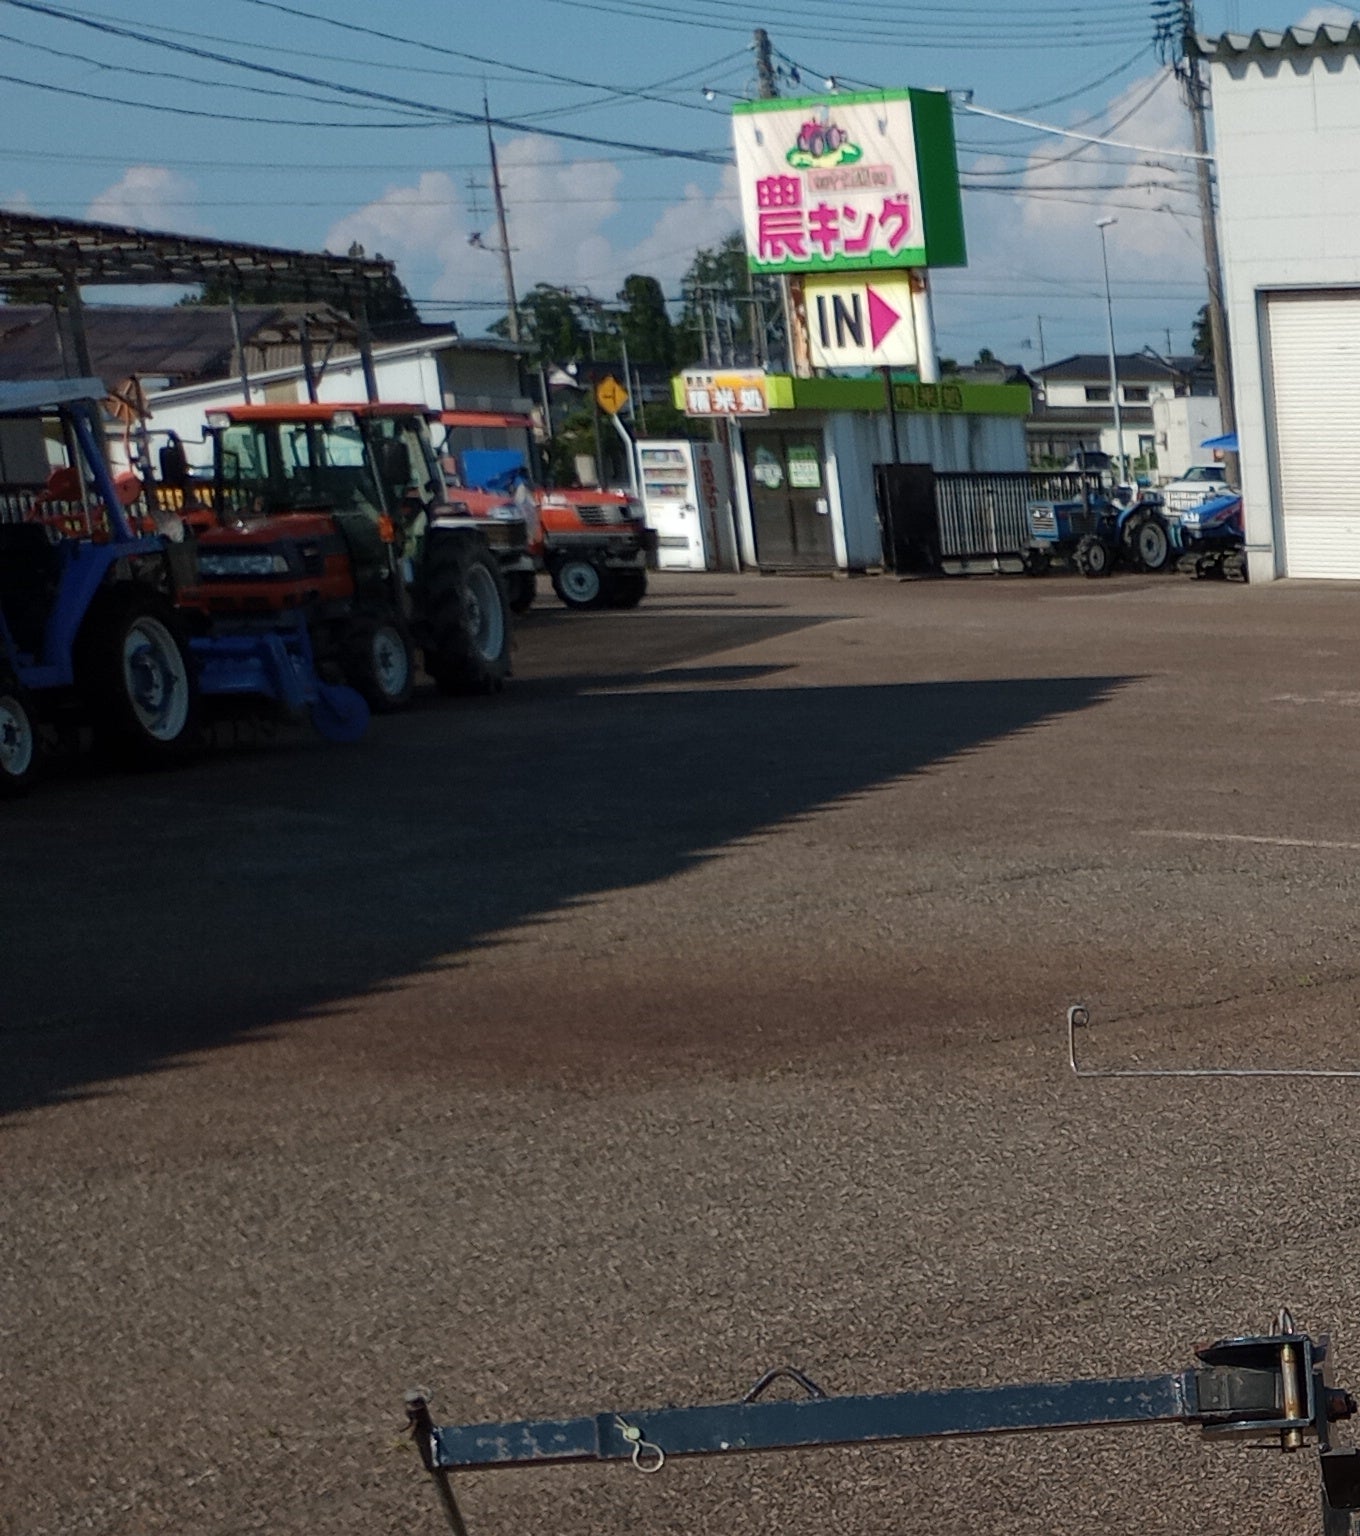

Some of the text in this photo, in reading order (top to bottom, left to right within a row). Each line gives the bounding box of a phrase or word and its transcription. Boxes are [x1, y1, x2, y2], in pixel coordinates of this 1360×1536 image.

[756, 175, 912, 259] 農キング
[815, 294, 863, 349] IN
